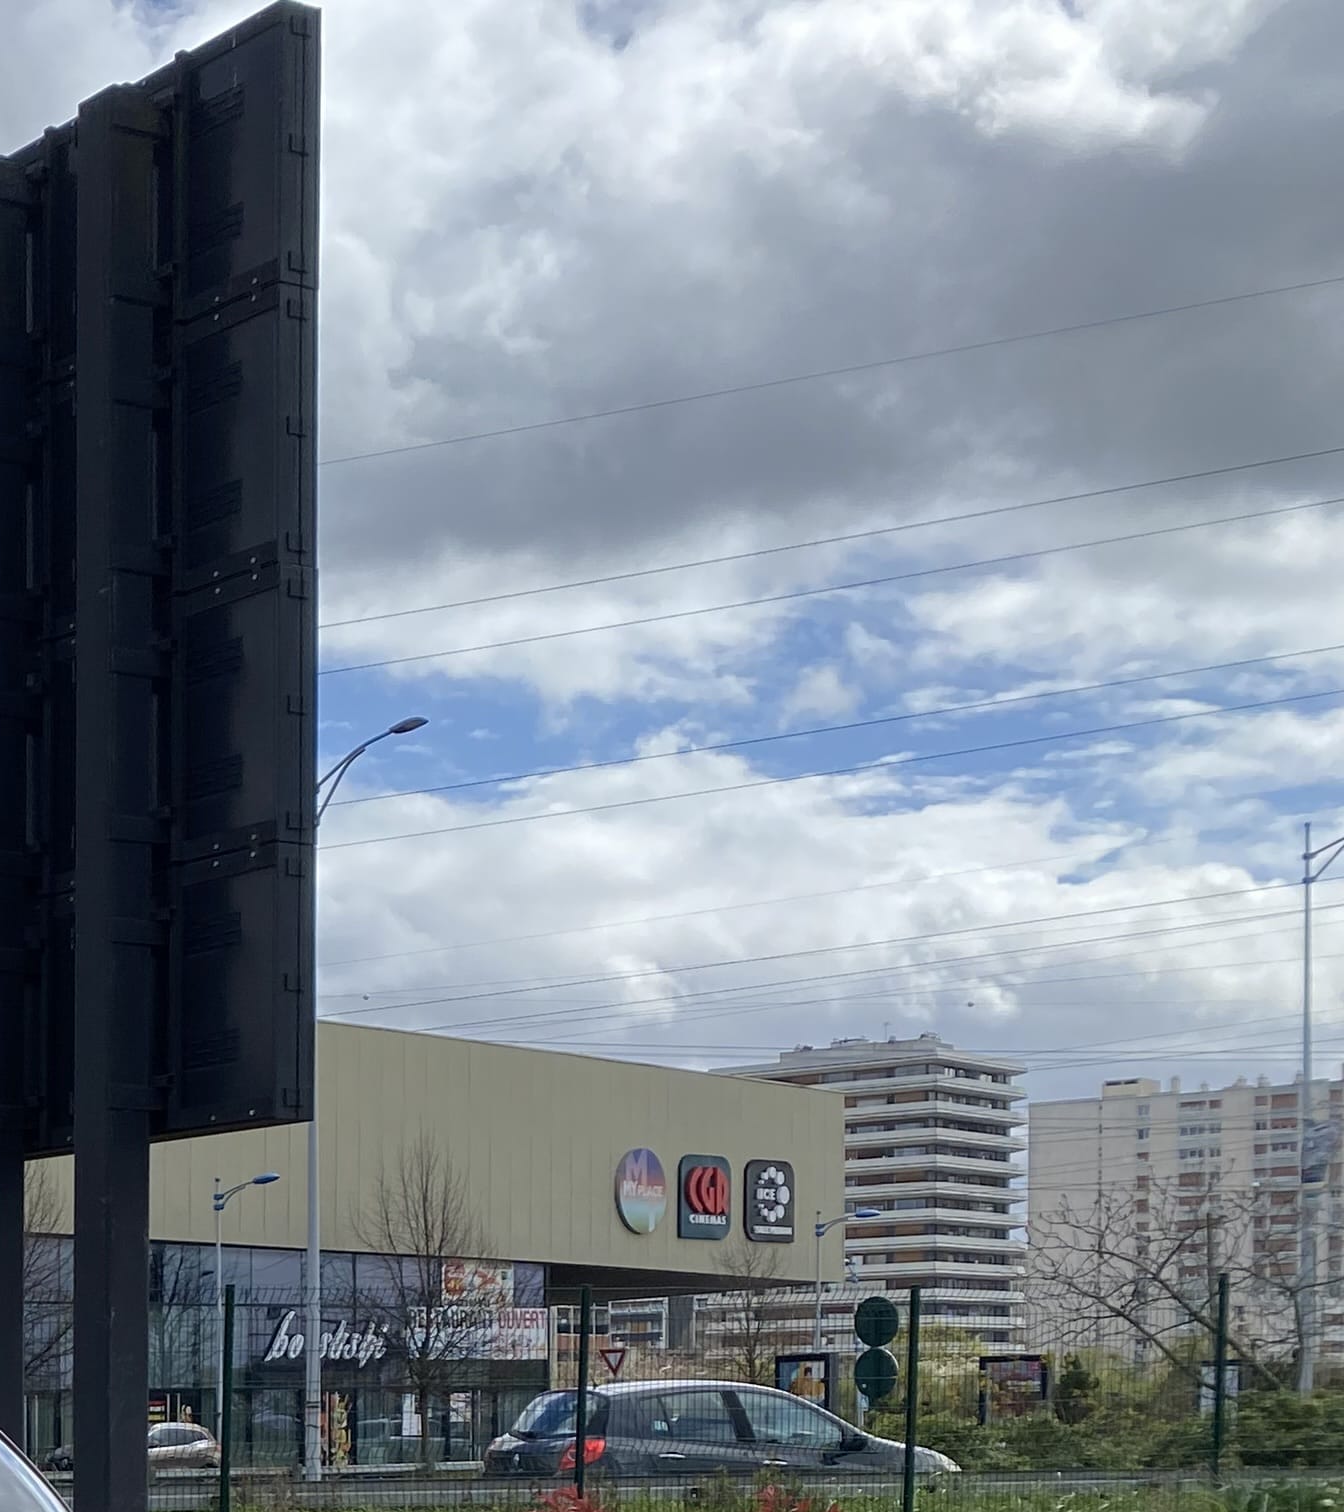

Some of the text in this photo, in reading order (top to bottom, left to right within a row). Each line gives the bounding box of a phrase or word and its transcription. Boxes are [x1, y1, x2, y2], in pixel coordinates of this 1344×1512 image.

[623, 1180, 665, 1198] MY PLACE
[688, 1166, 729, 1214] CGR
[498, 1308, 547, 1329] OUVERT
